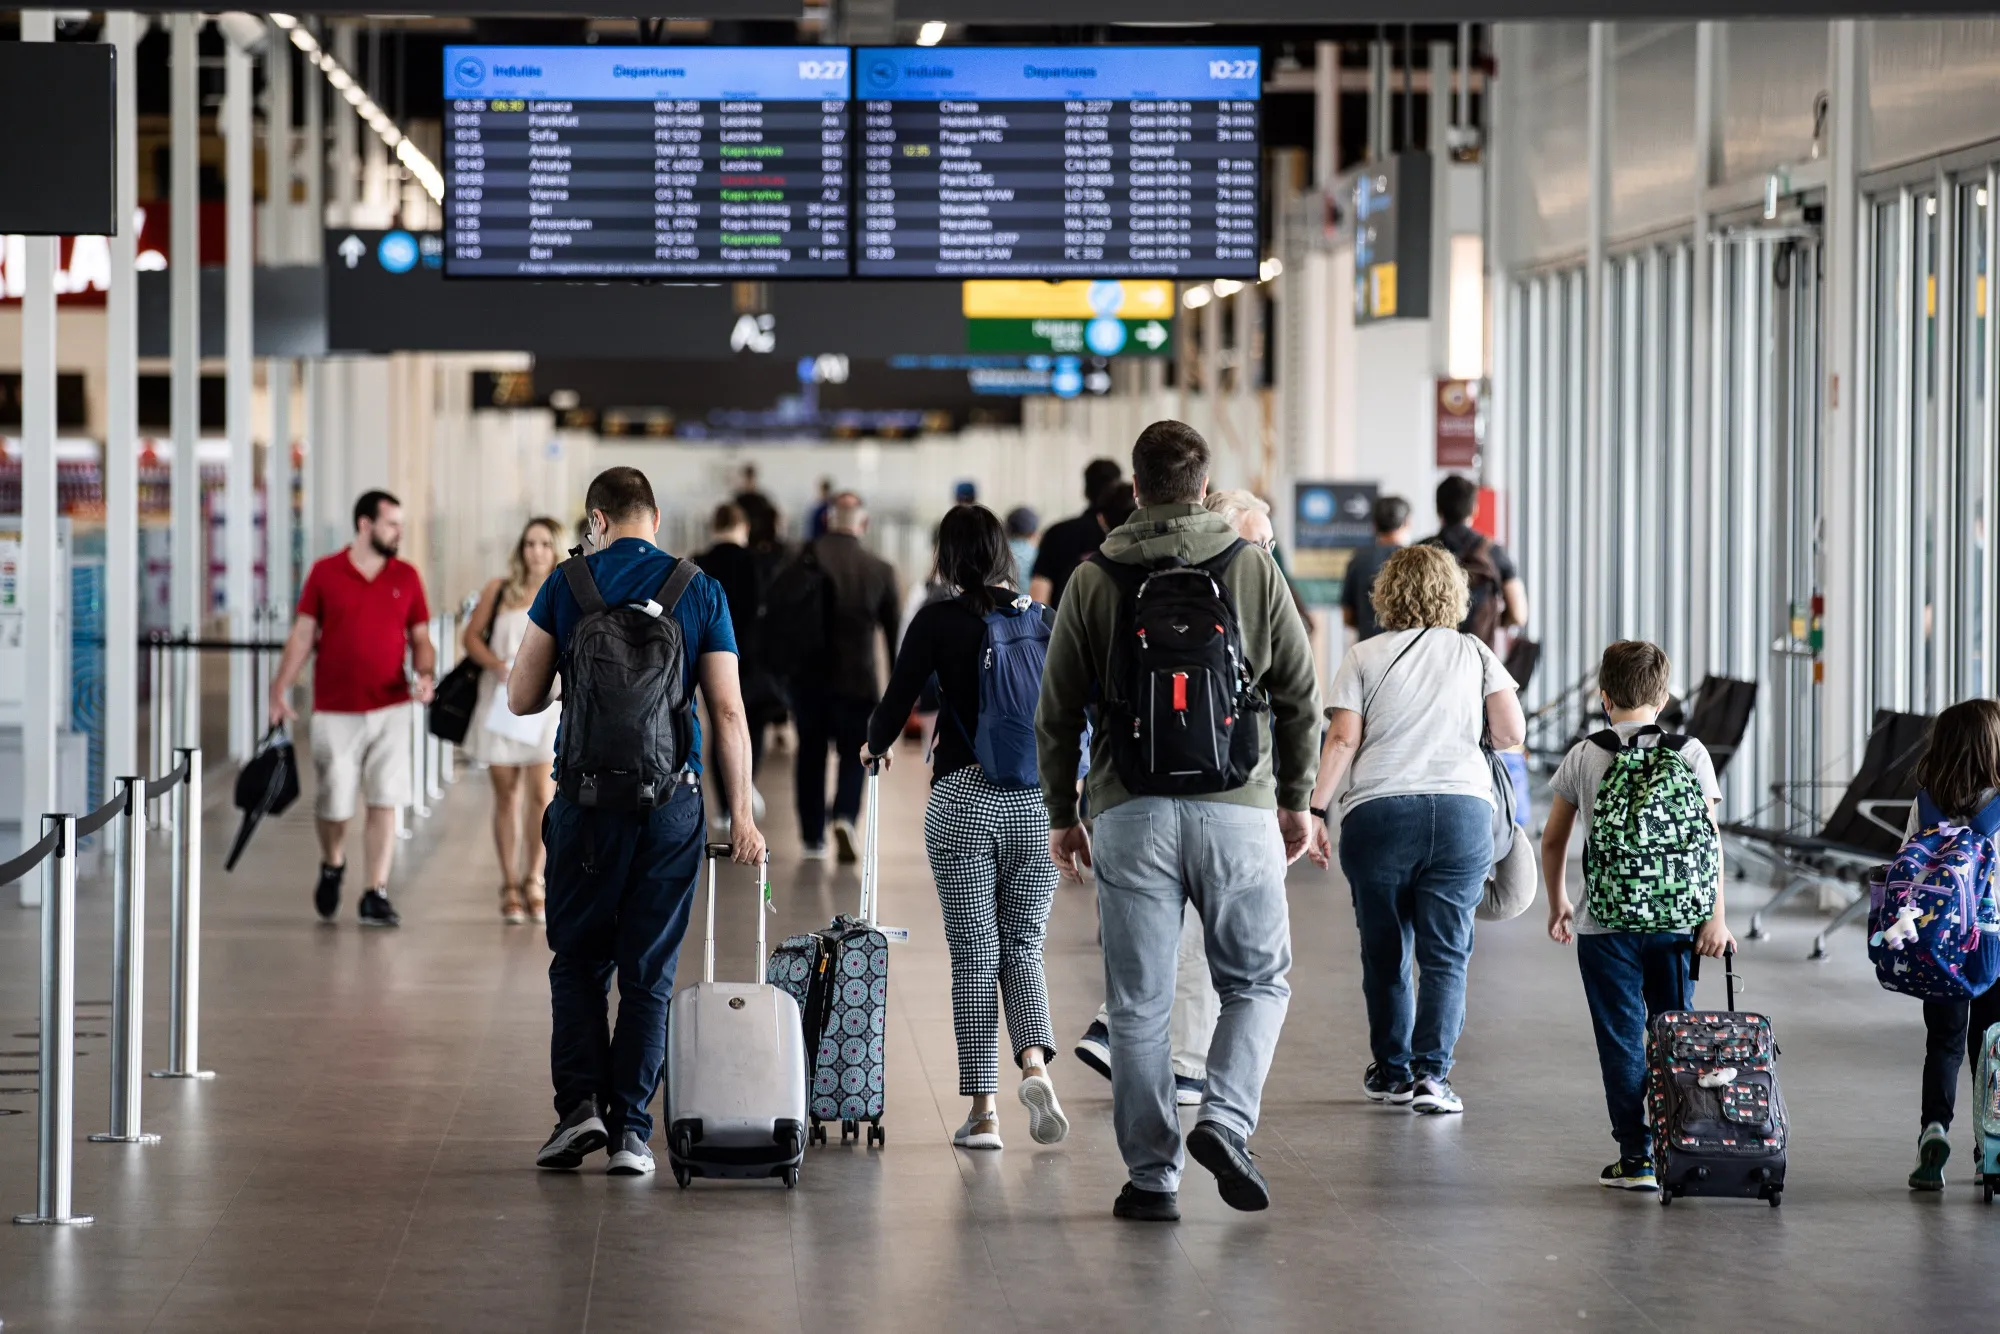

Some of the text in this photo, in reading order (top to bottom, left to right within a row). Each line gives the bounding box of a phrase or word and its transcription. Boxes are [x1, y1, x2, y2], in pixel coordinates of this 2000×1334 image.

[798, 61, 848, 80] 10:27
[1208, 61, 1258, 79] 10:27
[940, 101, 979, 113] Chania
[1157, 101, 1178, 113] info
[1179, 101, 1191, 113] in
[1232, 101, 1254, 113] min
[1157, 115, 1178, 127] info
[1179, 115, 1191, 127] in
[1232, 115, 1254, 127] min
[529, 130, 558, 142] Sofia
[940, 130, 978, 145] Prague
[1157, 130, 1178, 142] info
[1179, 130, 1191, 142] in
[1232, 130, 1254, 142] min
[529, 145, 571, 159] Antalya
[940, 145, 971, 157] Malta
[1130, 145, 1174, 159] Delayed
[455, 159, 485, 171] 10:40
[529, 159, 571, 174] Antalya
[940, 160, 982, 174] Antalya
[1157, 159, 1178, 171] info
[1179, 159, 1191, 171] in
[1232, 159, 1253, 171] min
[529, 174, 569, 186] Athens
[940, 174, 967, 186] Paris
[1157, 174, 1178, 186] info
[1179, 174, 1191, 186] in
[1232, 174, 1253, 186] min
[456, 188, 482, 200] 11:00
[529, 189, 569, 201] Vienna
[822, 189, 839, 201] A2
[939, 189, 1014, 201] Warsaw WAW
[1157, 189, 1178, 201] info
[1179, 189, 1191, 201] in
[1232, 189, 1253, 201] min
[529, 203, 552, 215] Bari
[720, 203, 750, 218] Kapu
[1157, 203, 1178, 215] info
[1179, 203, 1191, 215] in
[1232, 203, 1253, 215] min
[530, 218, 592, 230] Amsterdam
[720, 218, 750, 233] Kapu
[1157, 218, 1178, 230] info
[1179, 218, 1191, 230] in
[1232, 218, 1253, 230] min
[529, 233, 572, 247] Antalya
[1157, 233, 1178, 245] info
[1179, 233, 1191, 245] in
[1232, 233, 1253, 245] min
[456, 247, 481, 259] 11:40
[530, 247, 552, 259] Bari
[721, 247, 750, 262] Kapu
[940, 248, 1012, 260] Istanbul SAW
[1157, 247, 1178, 259] info
[1179, 247, 1190, 259] in
[1232, 247, 1253, 259] min
